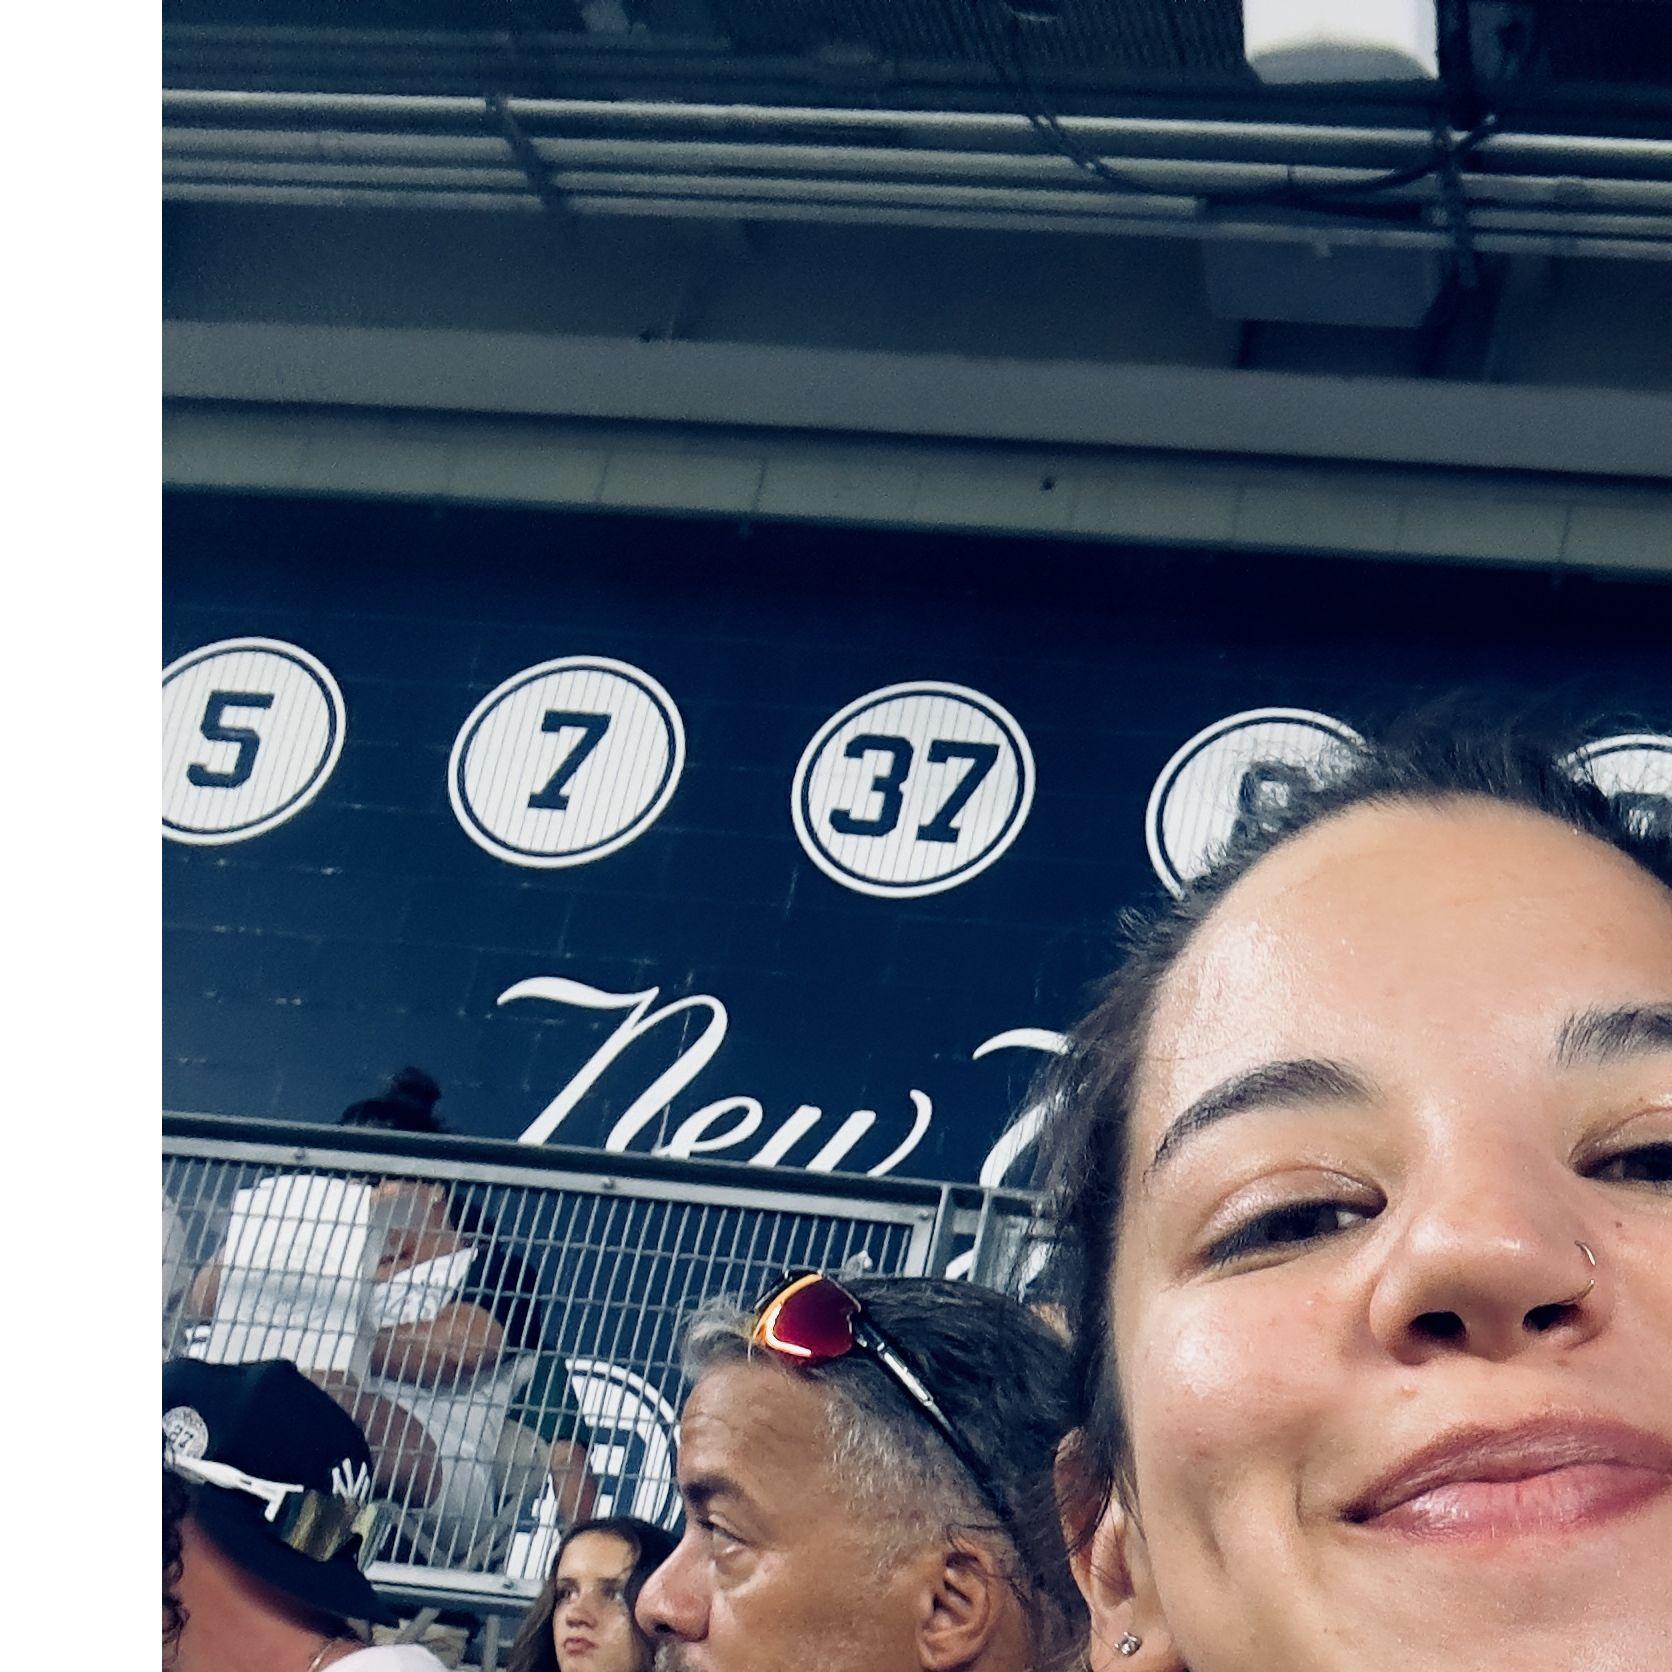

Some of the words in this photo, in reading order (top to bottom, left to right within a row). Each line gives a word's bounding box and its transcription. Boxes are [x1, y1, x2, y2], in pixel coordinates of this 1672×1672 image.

[187, 691, 274, 788] 5
[528, 711, 611, 810] 7
[829, 734, 1000, 843] 37
[497, 977, 932, 1177] New
